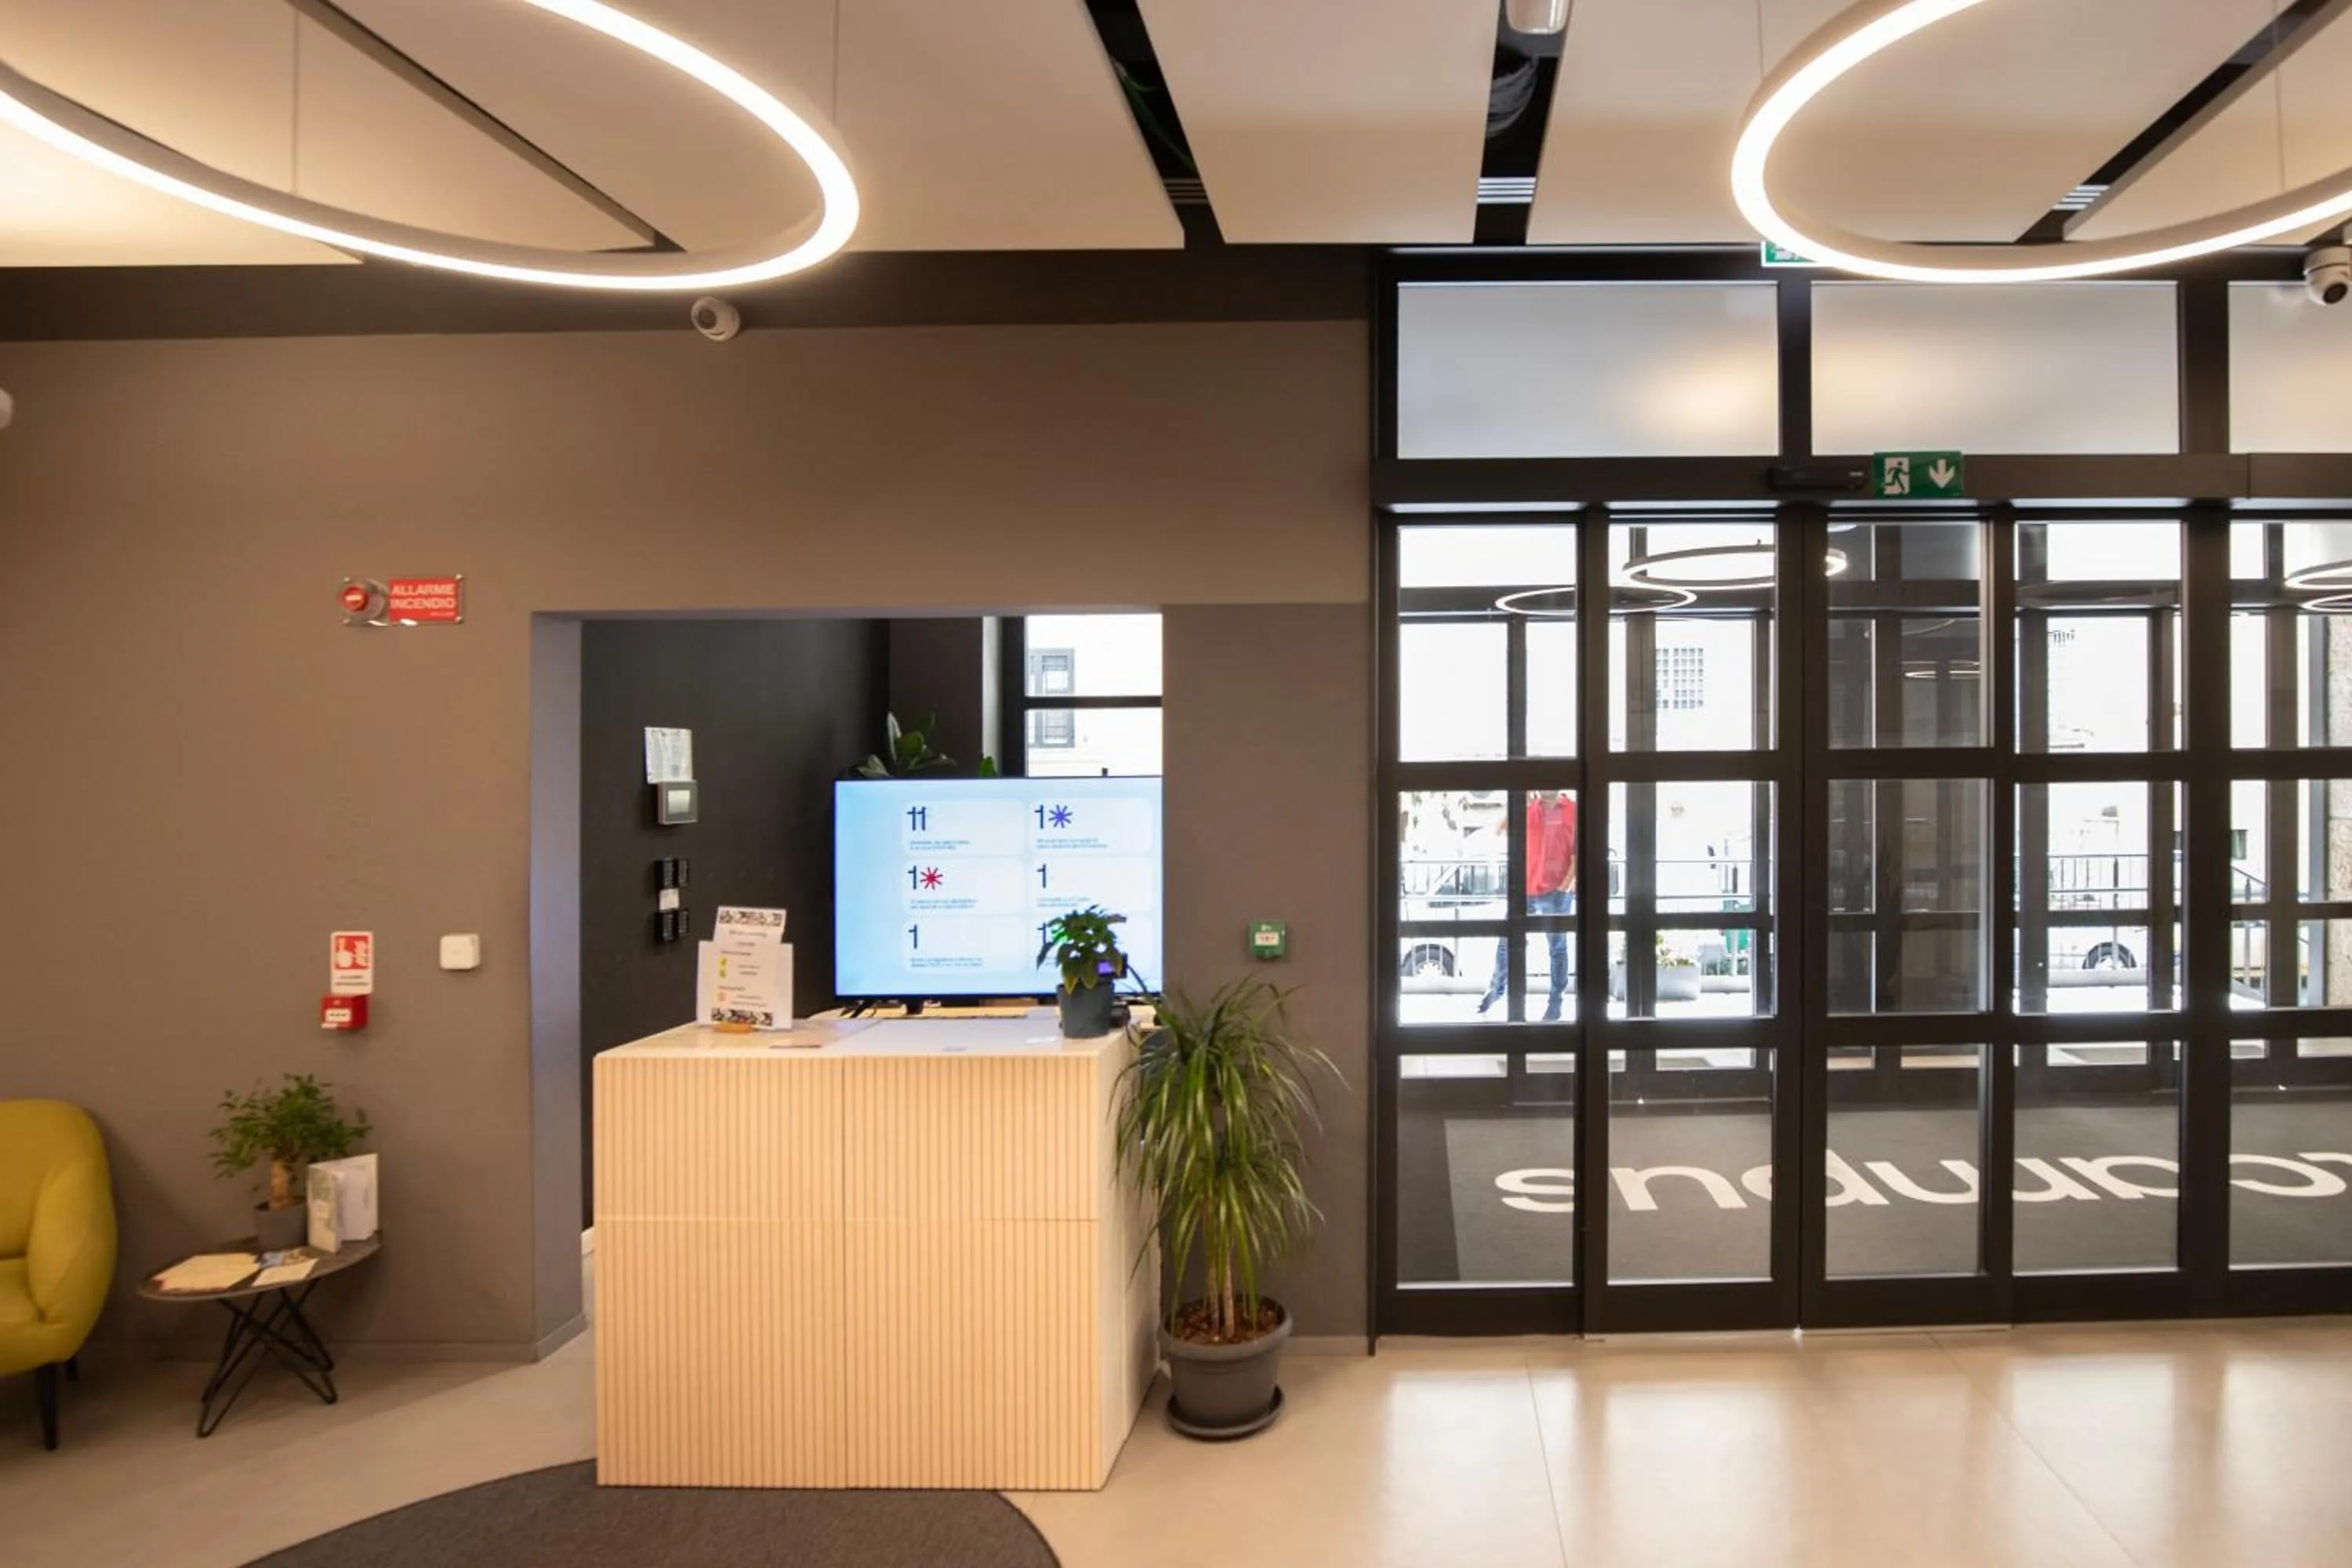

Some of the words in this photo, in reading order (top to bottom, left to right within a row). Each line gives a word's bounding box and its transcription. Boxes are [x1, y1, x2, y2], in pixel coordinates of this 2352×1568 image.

[392, 584, 456, 596] ALLARME
[390, 597, 456, 609] INCENDIO
[1494, 1148, 2352, 1213] campus
